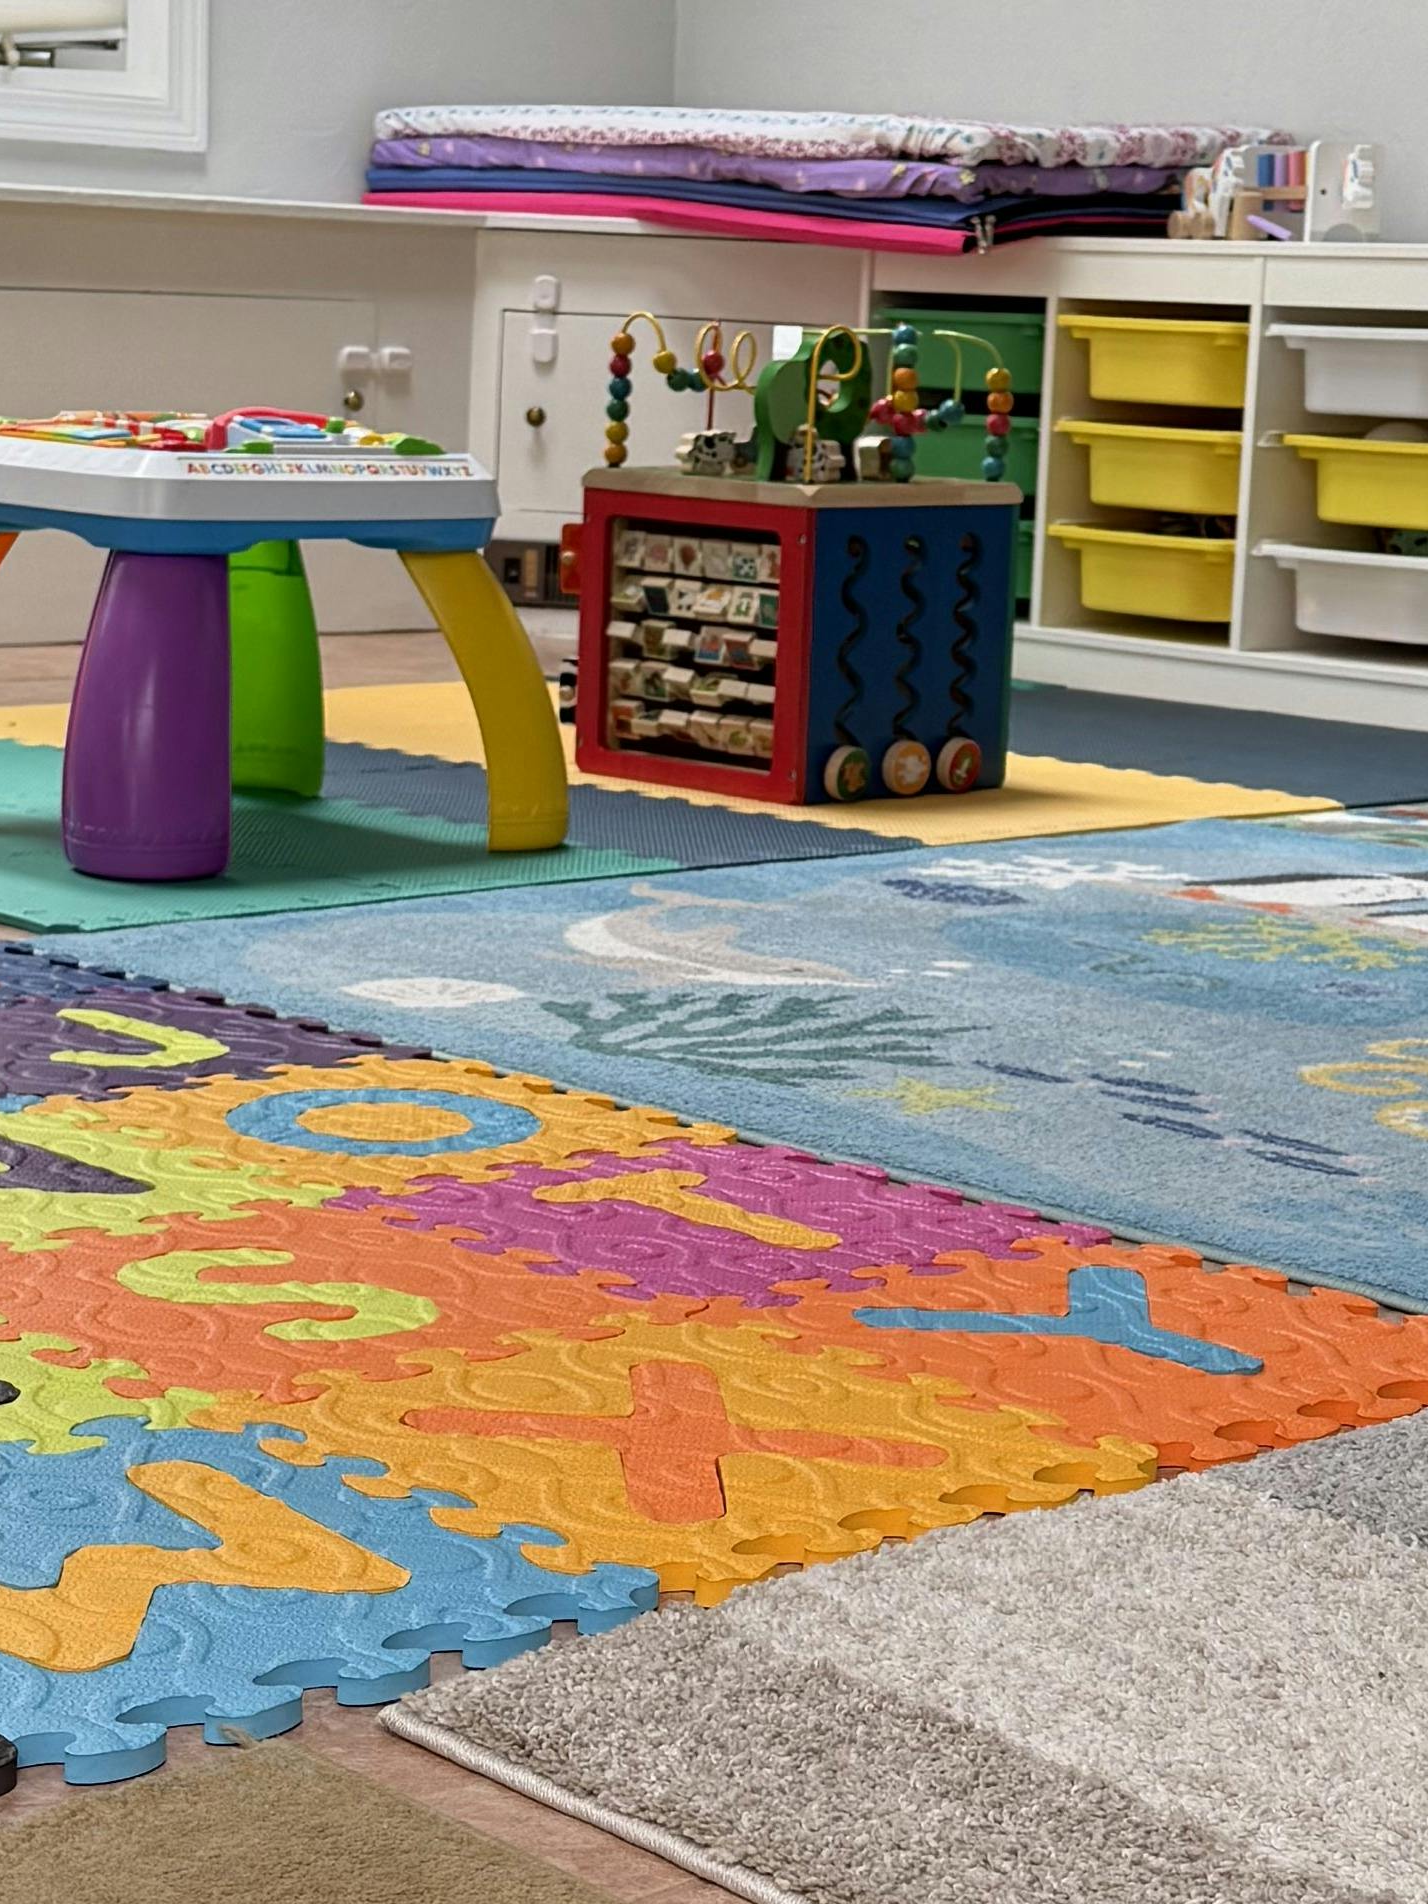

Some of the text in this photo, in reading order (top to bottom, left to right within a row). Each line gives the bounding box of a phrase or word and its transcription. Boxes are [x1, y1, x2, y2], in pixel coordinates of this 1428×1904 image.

[49, 1007, 231, 1070] J
[224, 1086, 543, 1157] O
[532, 1168, 844, 1250] T
[115, 1247, 440, 1342] S
[852, 1264, 1264, 1376] Y
[402, 1358, 950, 1524] X
